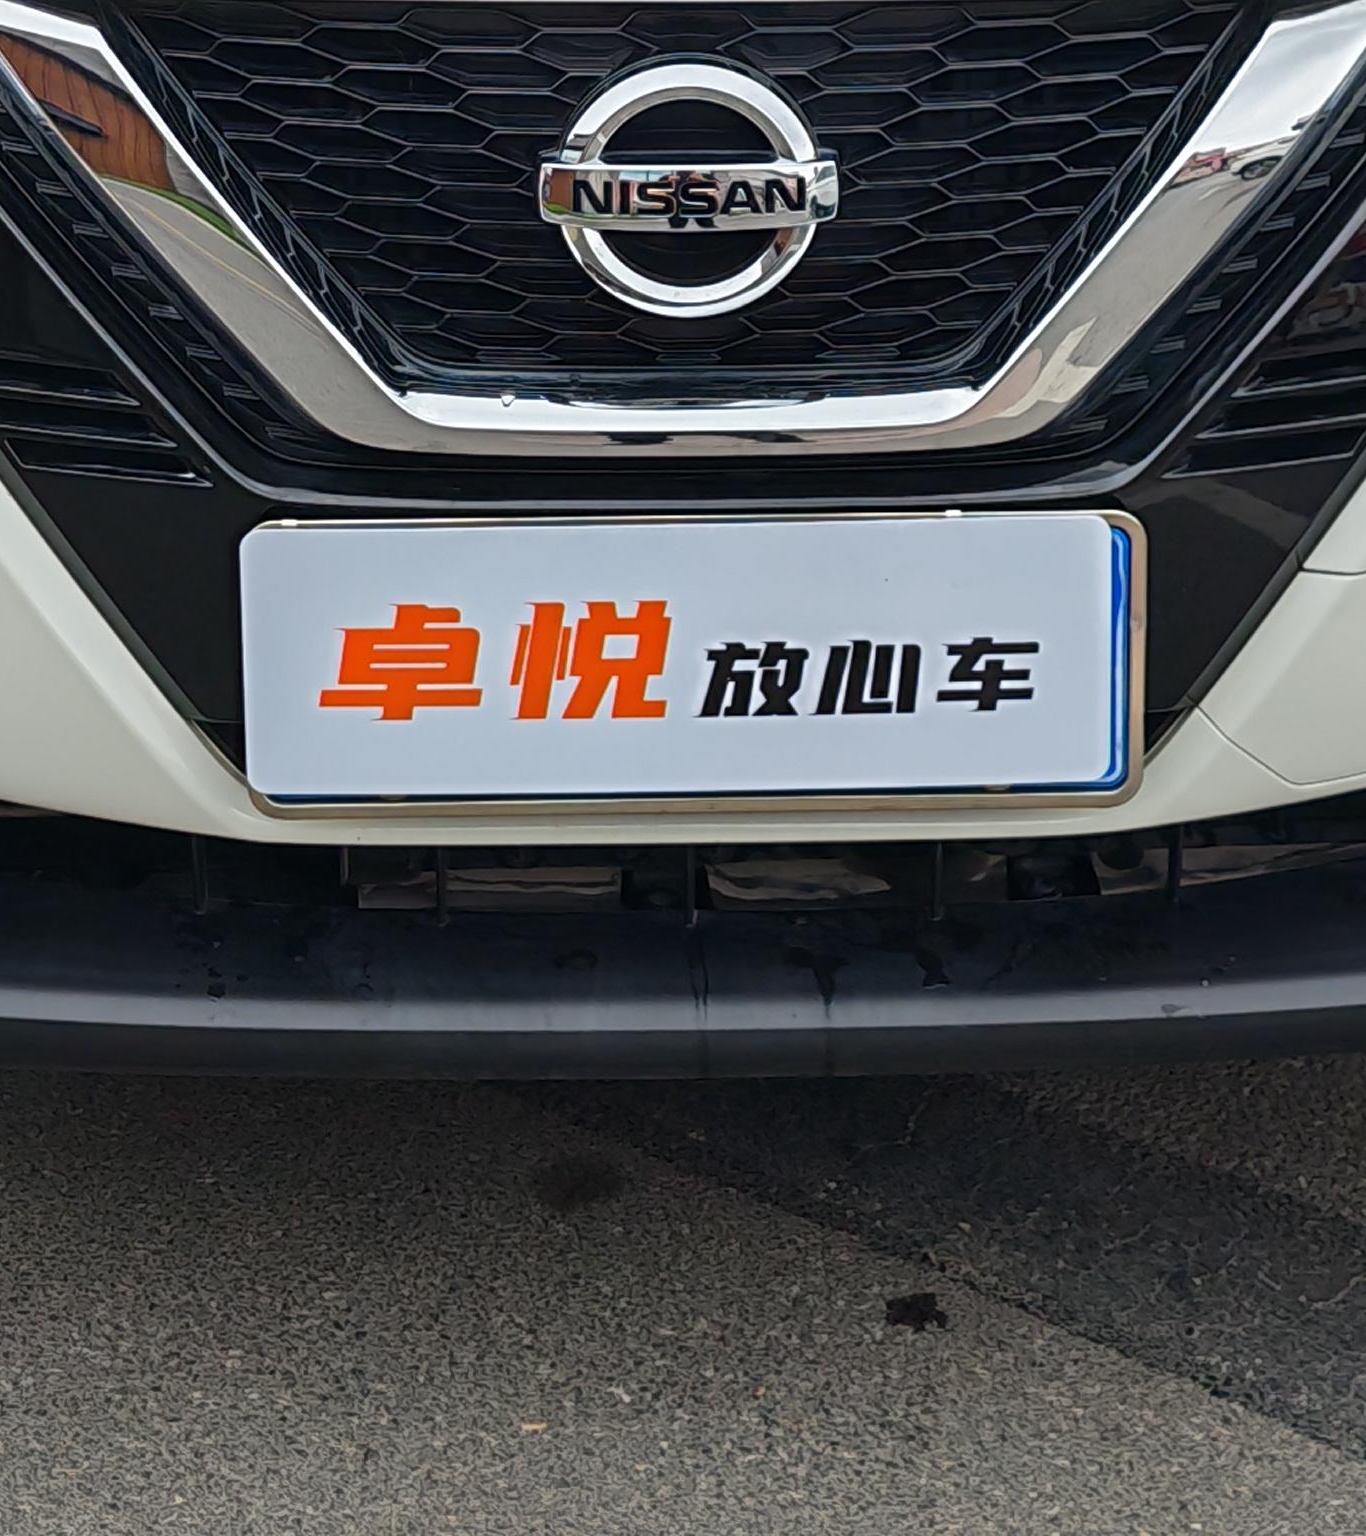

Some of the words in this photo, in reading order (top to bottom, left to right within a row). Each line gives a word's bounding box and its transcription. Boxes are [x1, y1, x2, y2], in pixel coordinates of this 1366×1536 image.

[572, 175, 807, 216] NISSAN
[318, 599, 673, 721] 卓悦
[692, 636, 1040, 719] 放心车
